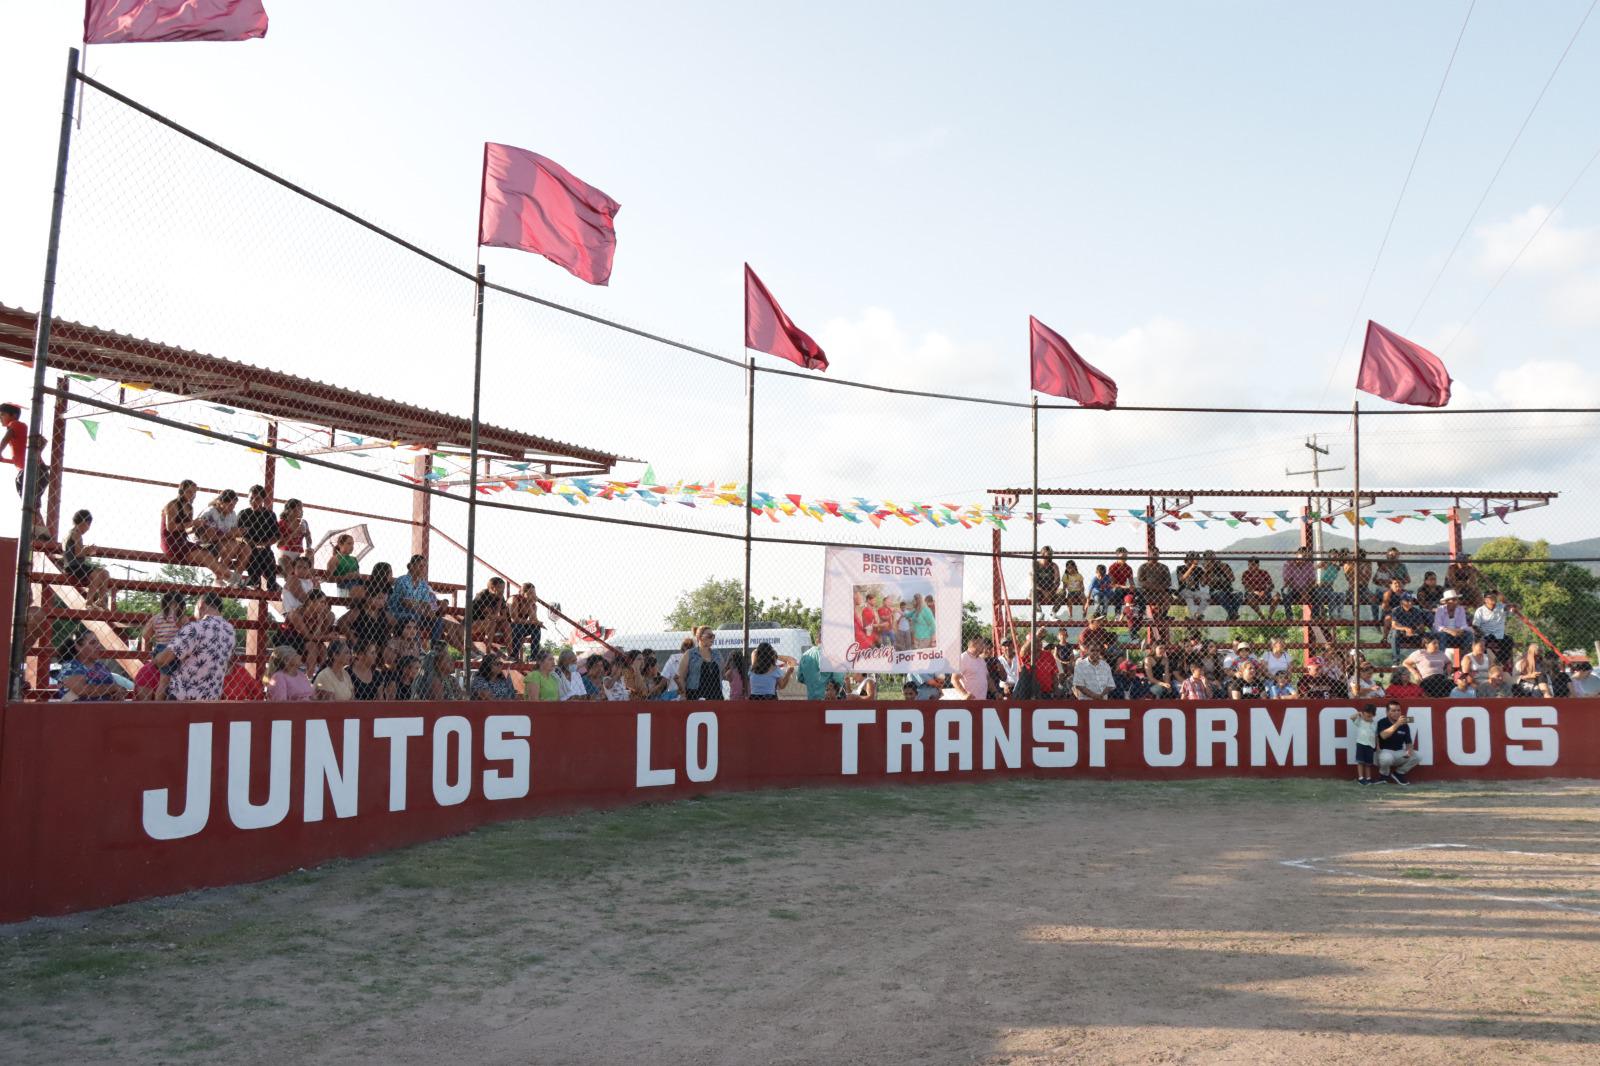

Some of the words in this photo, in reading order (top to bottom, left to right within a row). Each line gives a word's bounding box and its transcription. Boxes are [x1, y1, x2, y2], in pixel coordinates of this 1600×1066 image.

[863, 553, 933, 566] BIENVENIDA
[863, 563, 933, 577] PRESIDENTA
[845, 642, 894, 669] Gracias
[896, 653, 915, 664] ¡Por
[917, 650, 943, 661] Todo!
[142, 714, 531, 840] JUNTOS
[636, 711, 719, 788] LO
